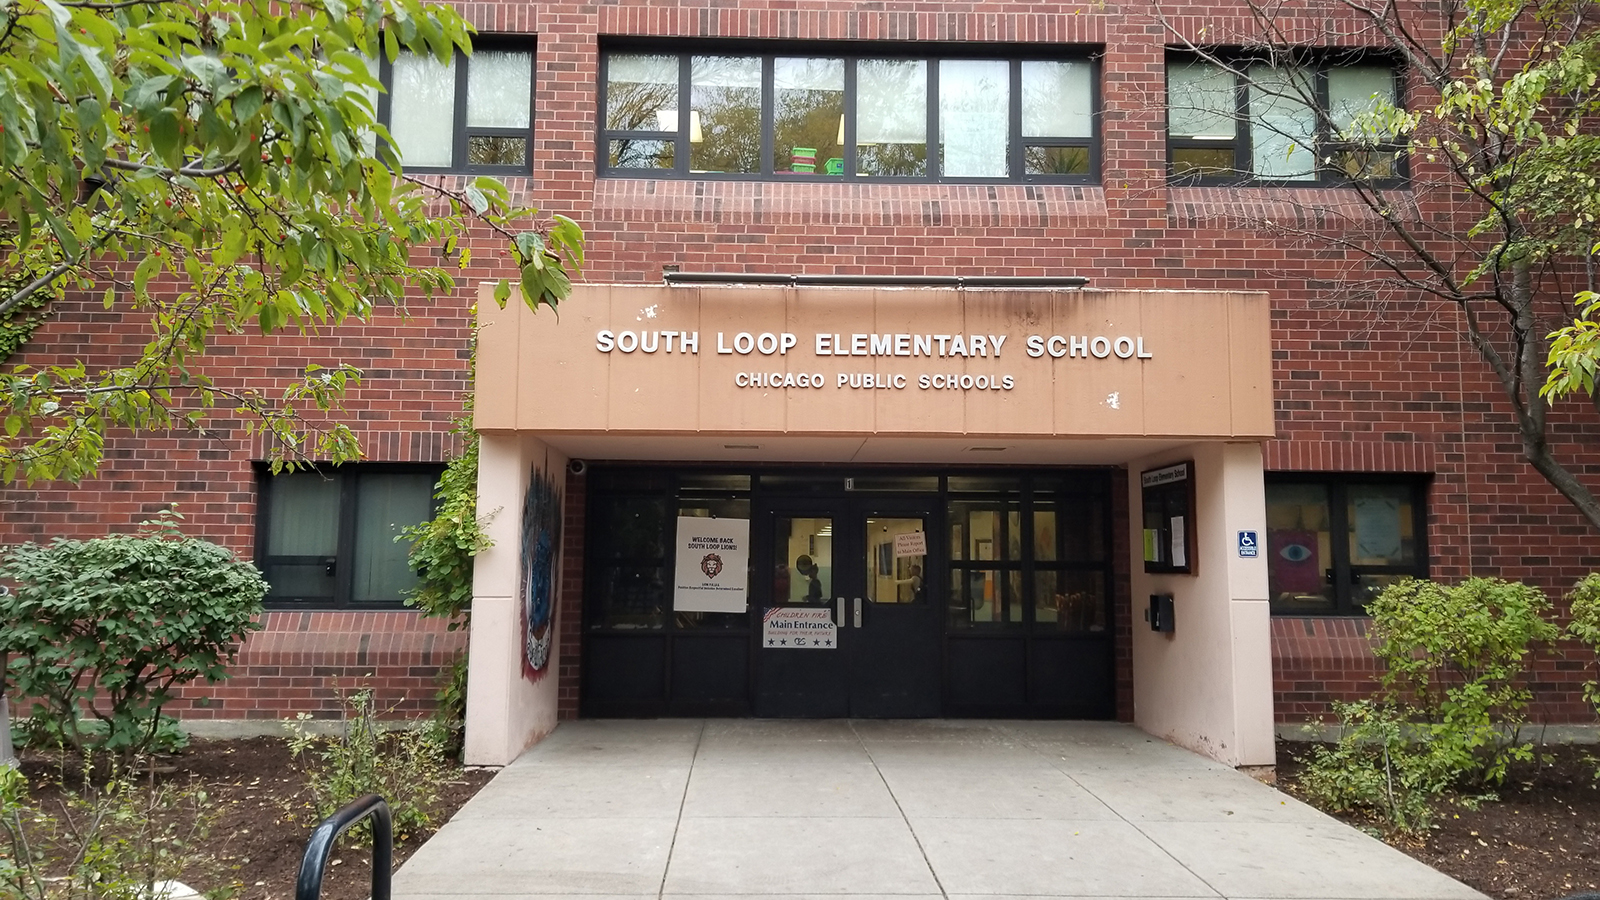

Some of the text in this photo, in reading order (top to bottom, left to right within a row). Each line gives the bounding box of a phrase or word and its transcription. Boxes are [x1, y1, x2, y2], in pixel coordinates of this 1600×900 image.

[596, 329, 1153, 360] SOUTH LOOP ELEMENTARY SCHOOL
[735, 372, 1015, 391] CHICAGO PUBLIC SCHOOLS
[1174, 468, 1185, 478] School
[769, 620, 834, 629] Main Entrance
